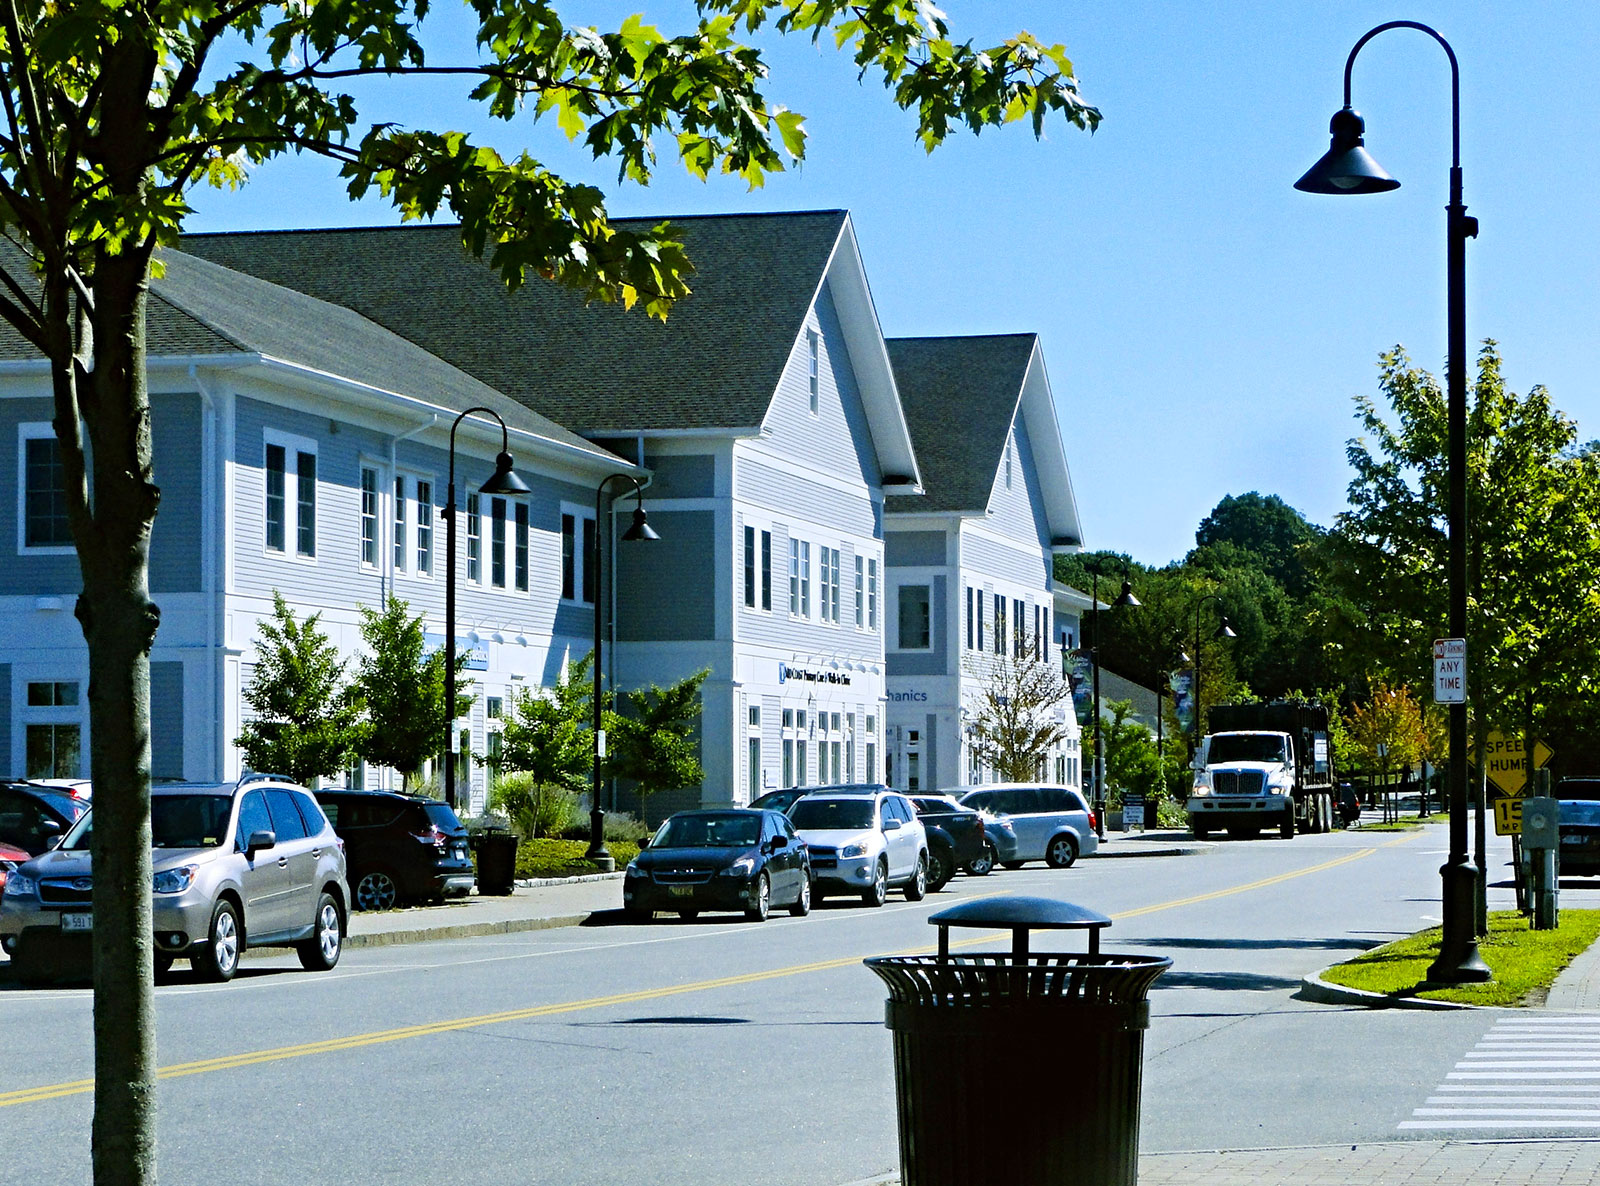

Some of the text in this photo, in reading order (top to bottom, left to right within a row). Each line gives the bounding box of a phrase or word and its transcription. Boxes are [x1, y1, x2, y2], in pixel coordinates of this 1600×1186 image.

[1440, 661, 1460, 672] ANY
[1440, 677, 1460, 689] TIME
[886, 689, 927, 701] hanics
[1486, 740, 1526, 753] SPEE
[1501, 802, 1521, 820] 15
[1502, 823, 1519, 831] MP
